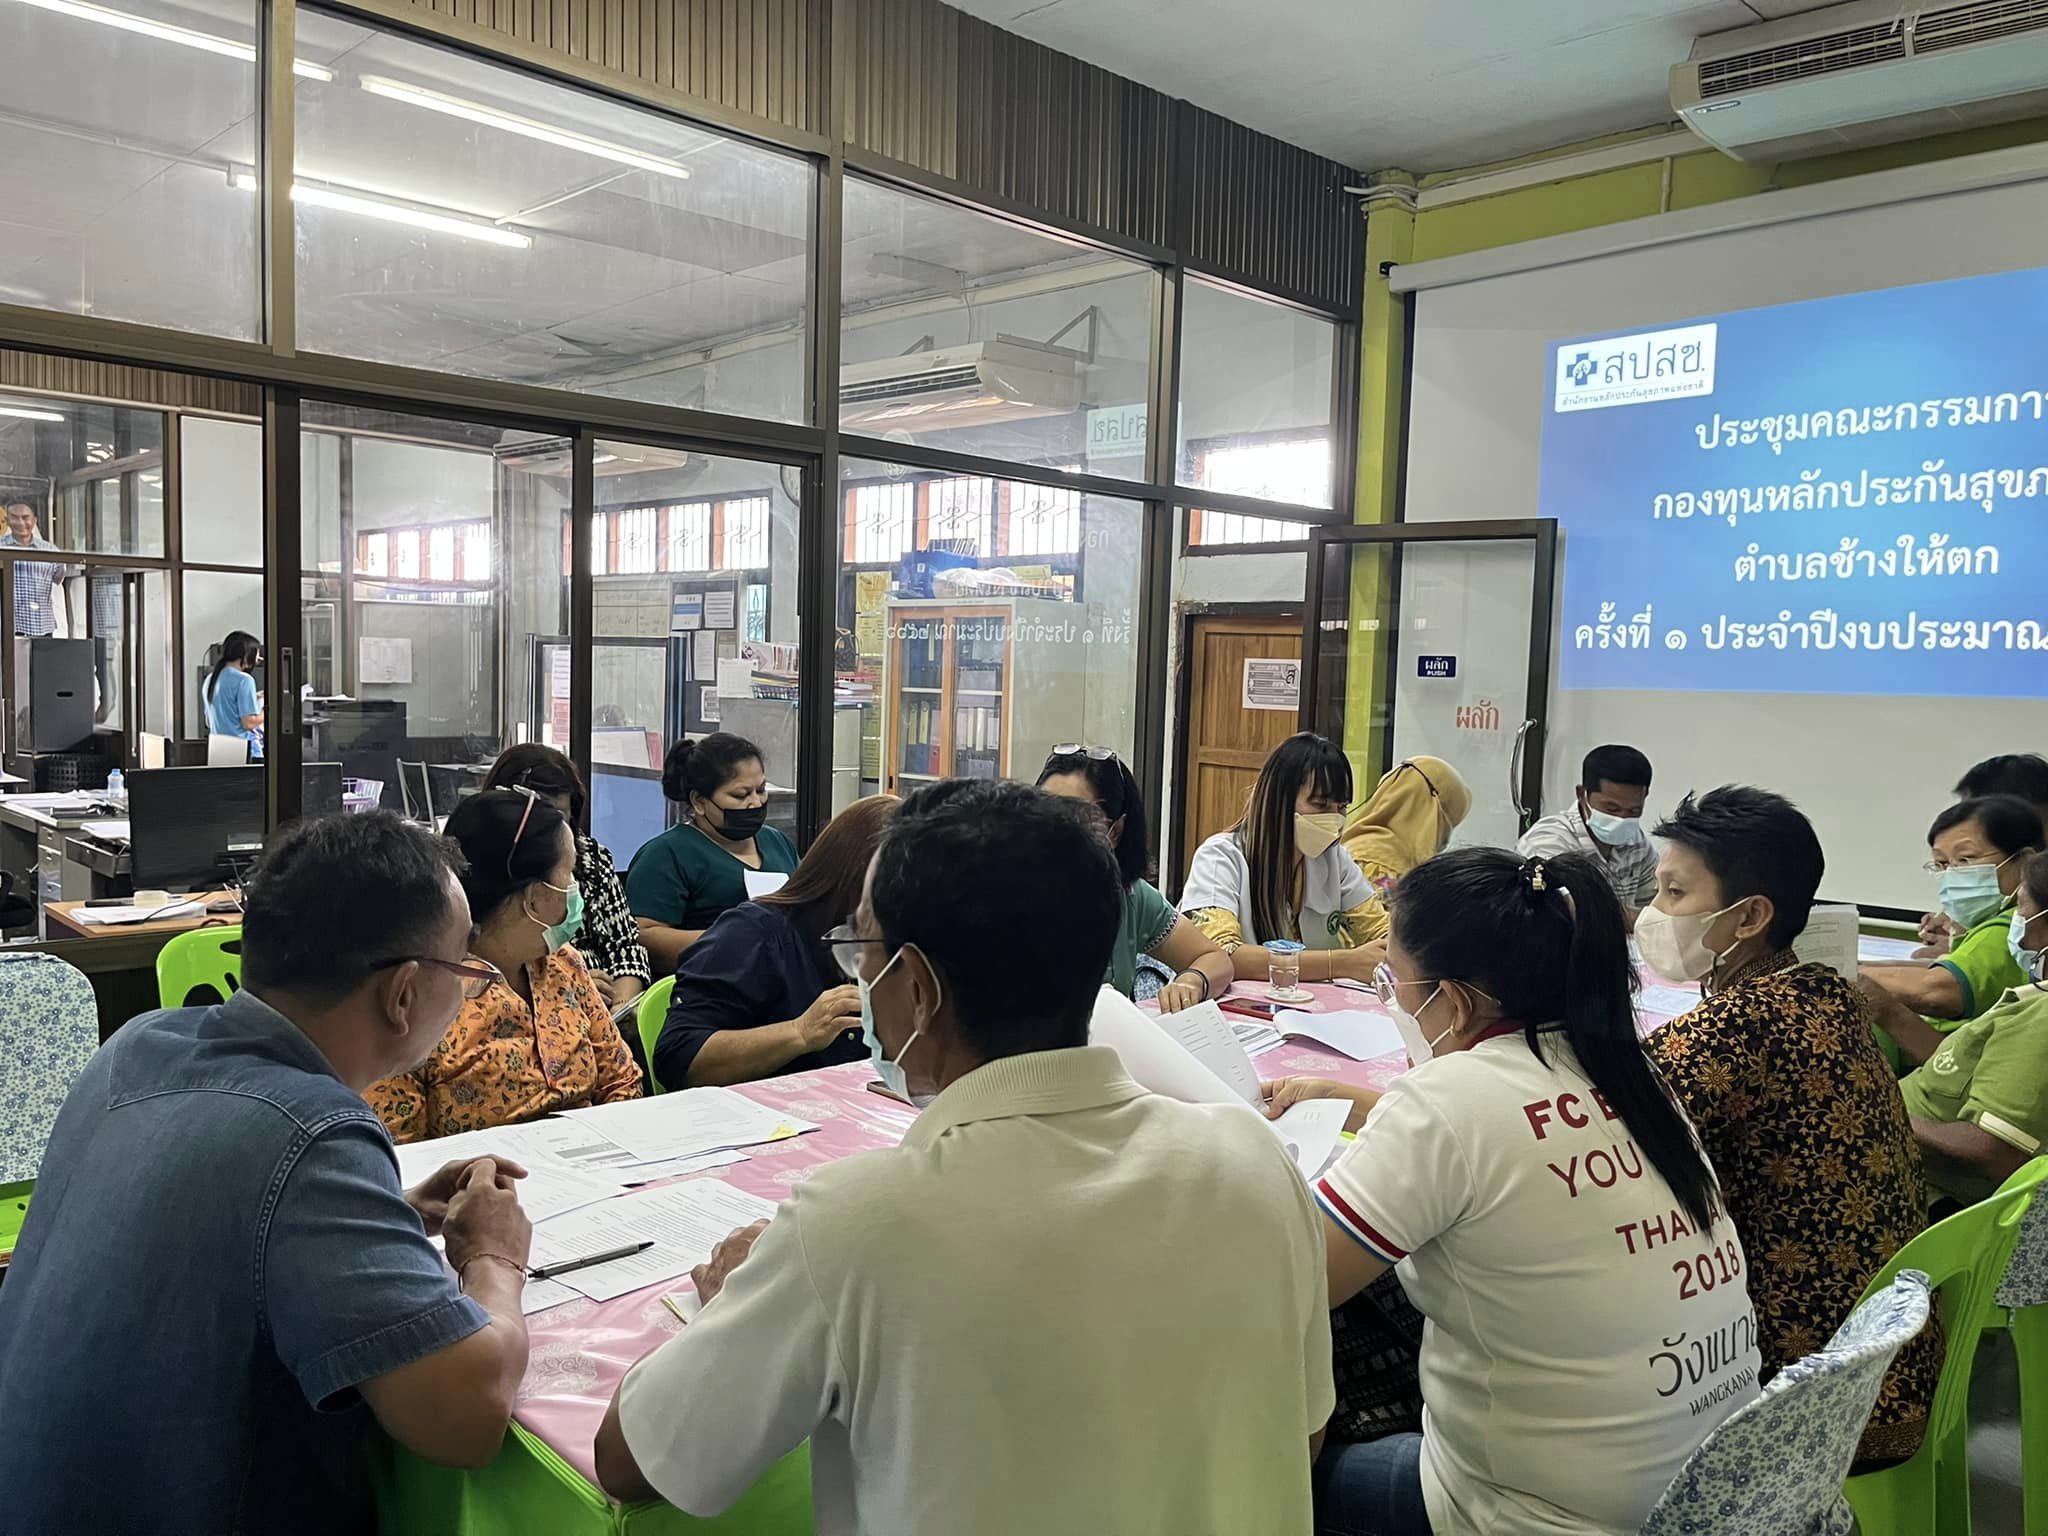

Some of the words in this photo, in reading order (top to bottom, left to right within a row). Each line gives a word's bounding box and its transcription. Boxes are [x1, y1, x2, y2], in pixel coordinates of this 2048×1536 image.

[1695, 390, 2048, 455] ประชุมคณะกรรมกา
[1734, 533, 1999, 582] ตำบลช้างให้ตก
[1575, 601, 1652, 649] ครั้งที่
[1664, 629, 1687, 650] ๑
[1701, 608, 2048, 650] ประจำปีงบประมาณ
[1425, 657, 1449, 670] ผลัก
[1456, 699, 1499, 730] ผลัก
[1523, 1093, 1589, 1140] FC
[1547, 1140, 1642, 1198] YOU
[1672, 1239, 1740, 1300] 2018
